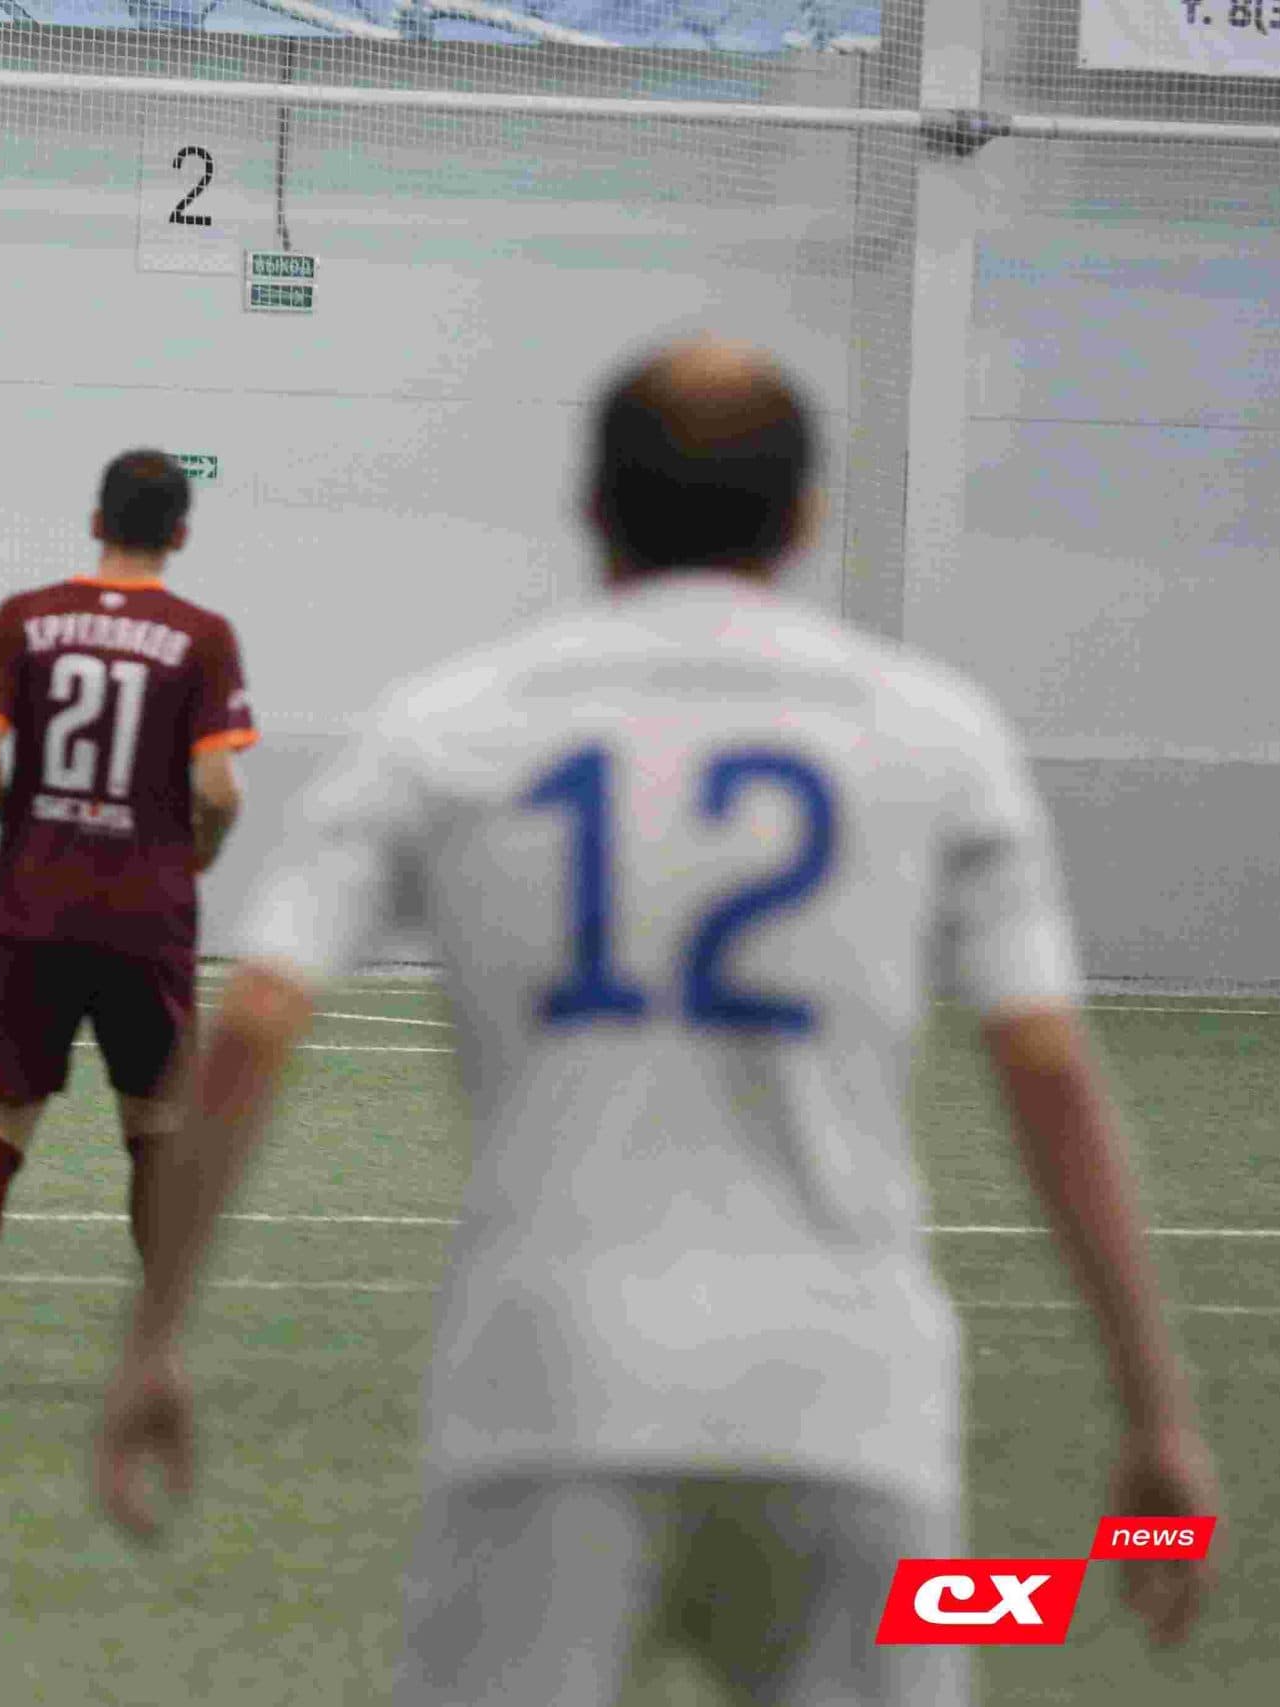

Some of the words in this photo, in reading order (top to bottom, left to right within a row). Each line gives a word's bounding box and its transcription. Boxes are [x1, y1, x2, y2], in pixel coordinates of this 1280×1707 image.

[169, 146, 214, 226] 2
[42, 652, 150, 798] 21
[517, 740, 838, 1040] 12
